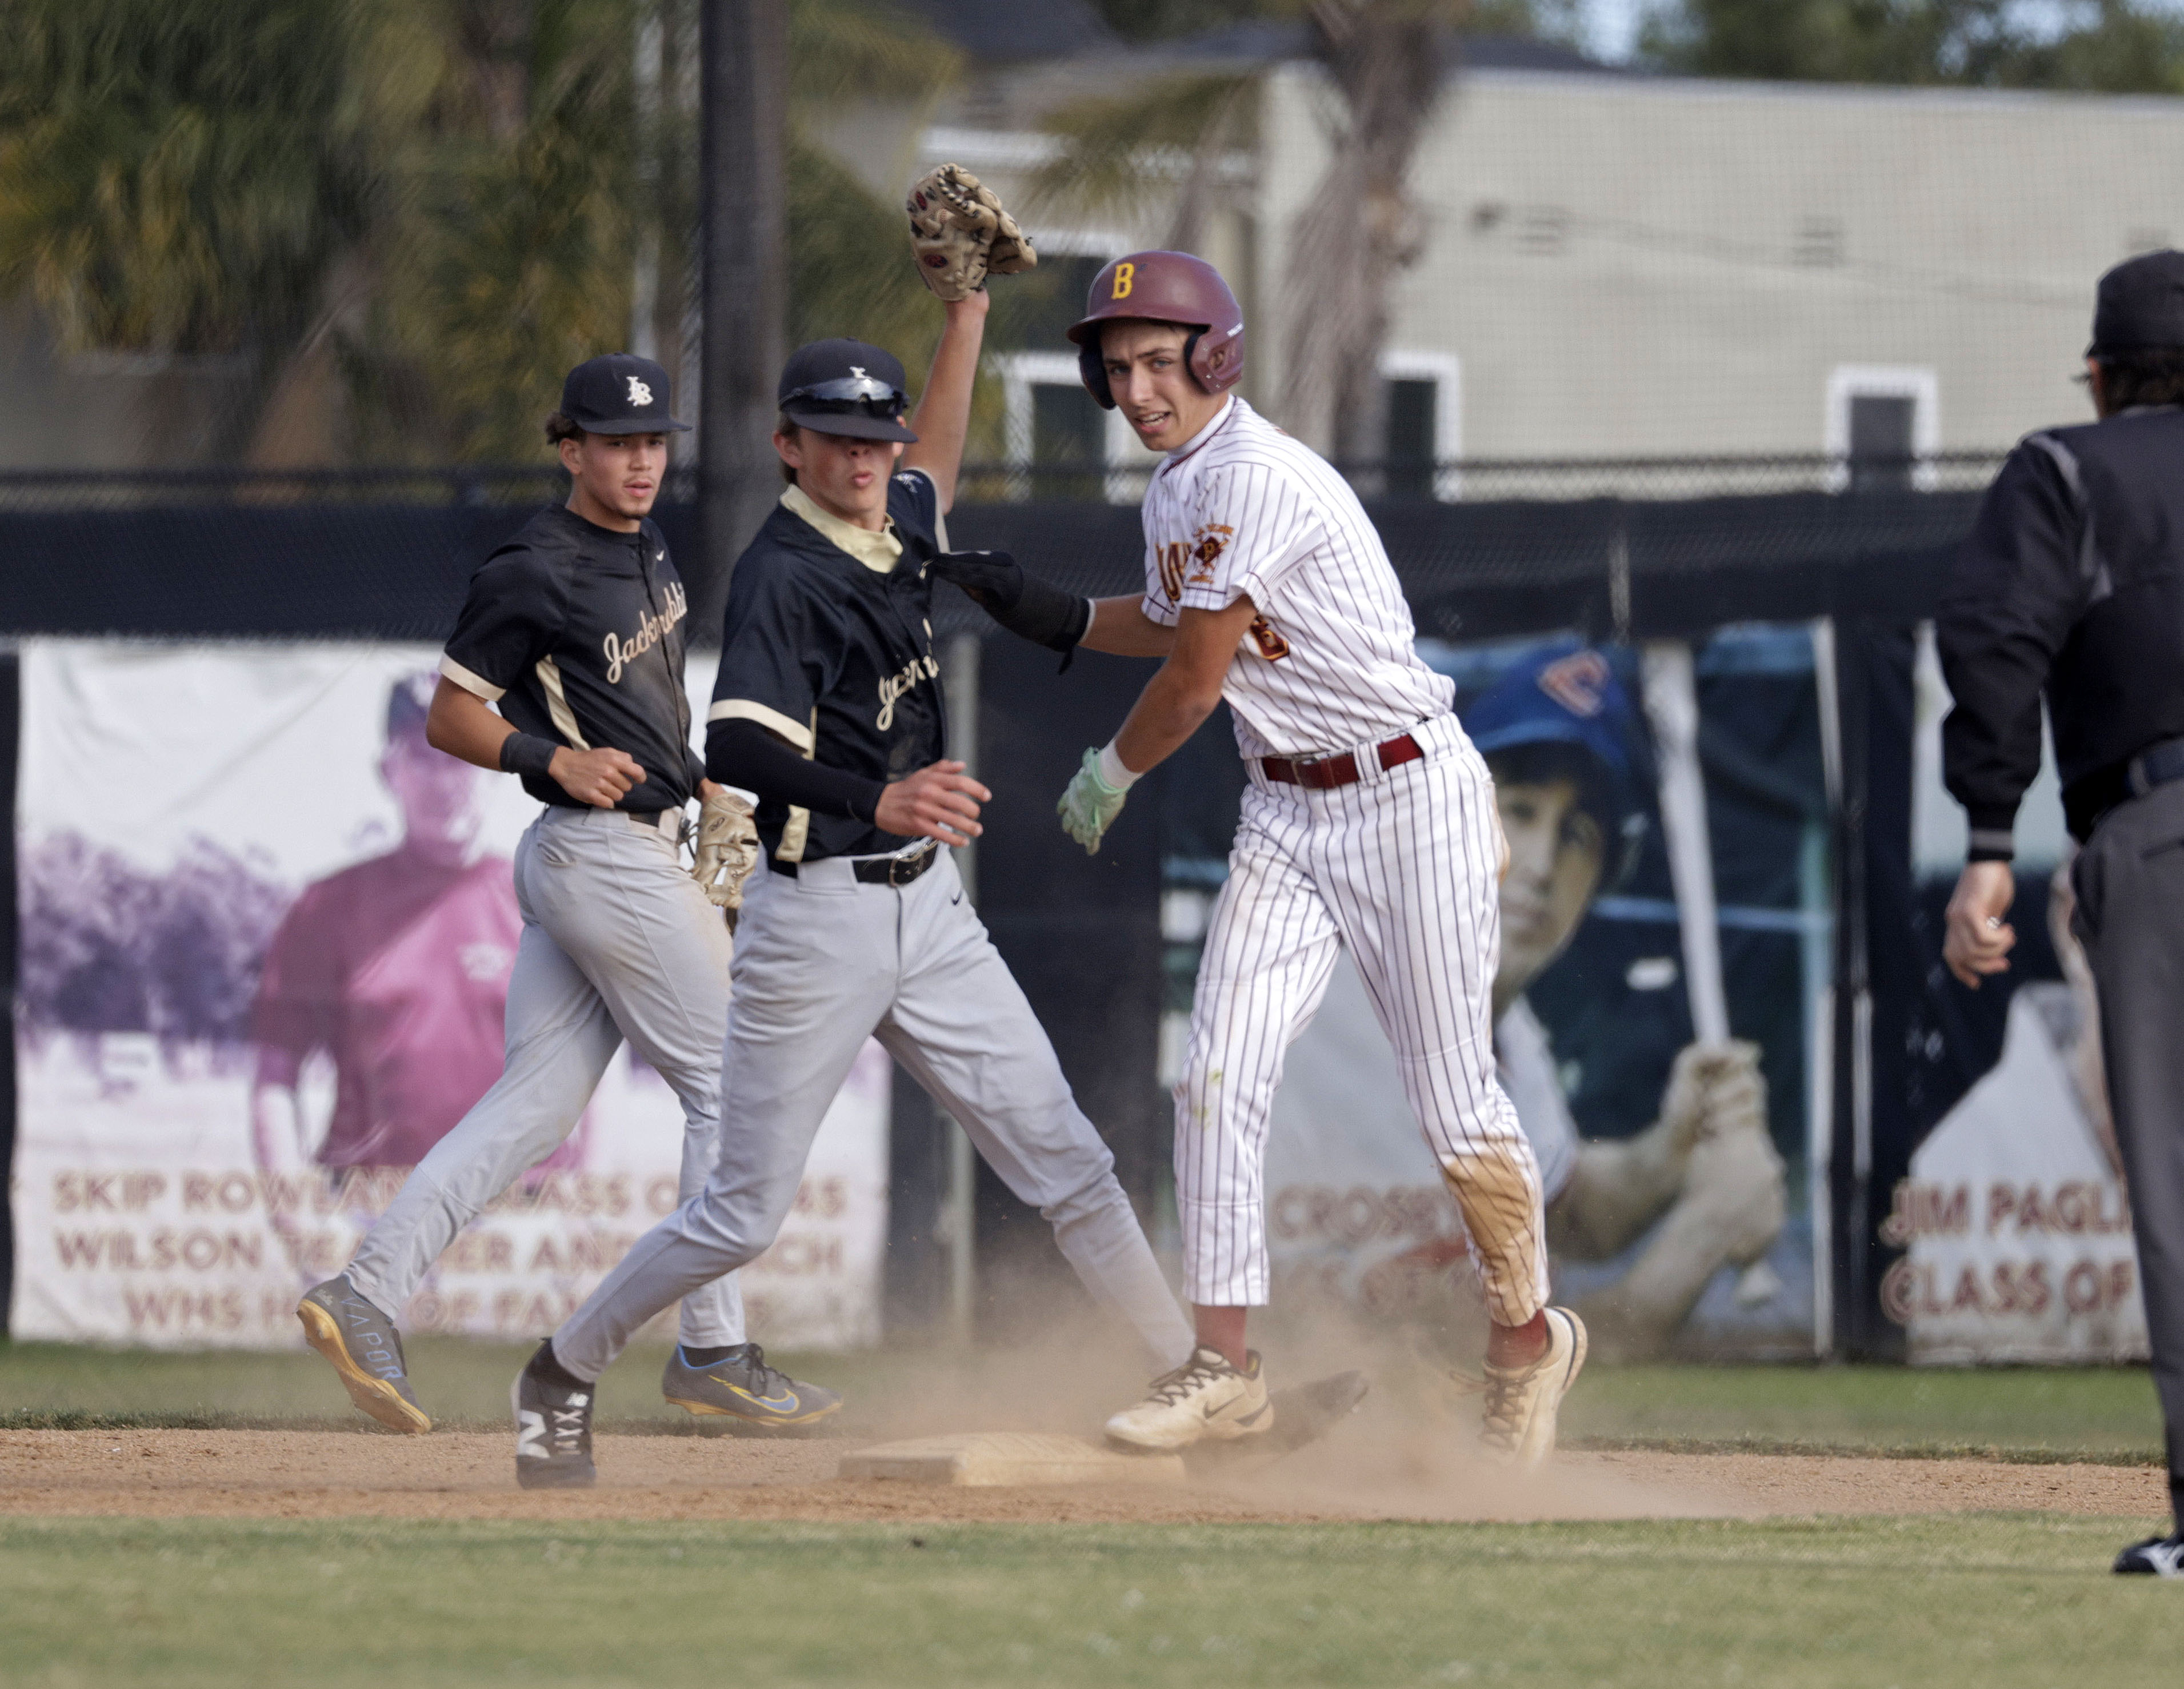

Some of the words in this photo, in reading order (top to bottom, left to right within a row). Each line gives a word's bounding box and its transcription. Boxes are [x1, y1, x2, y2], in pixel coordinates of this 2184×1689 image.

[1111, 262, 1135, 300] B
[626, 376, 654, 407] LB
[603, 582, 687, 684] Jackrabbi
[53, 1171, 167, 1214] SKIP
[54, 1229, 263, 1271] WILSON
[122, 1285, 245, 1331] WHS
[1879, 1256, 2051, 1324] CLASS
[2063, 1257, 2136, 1312] OF
